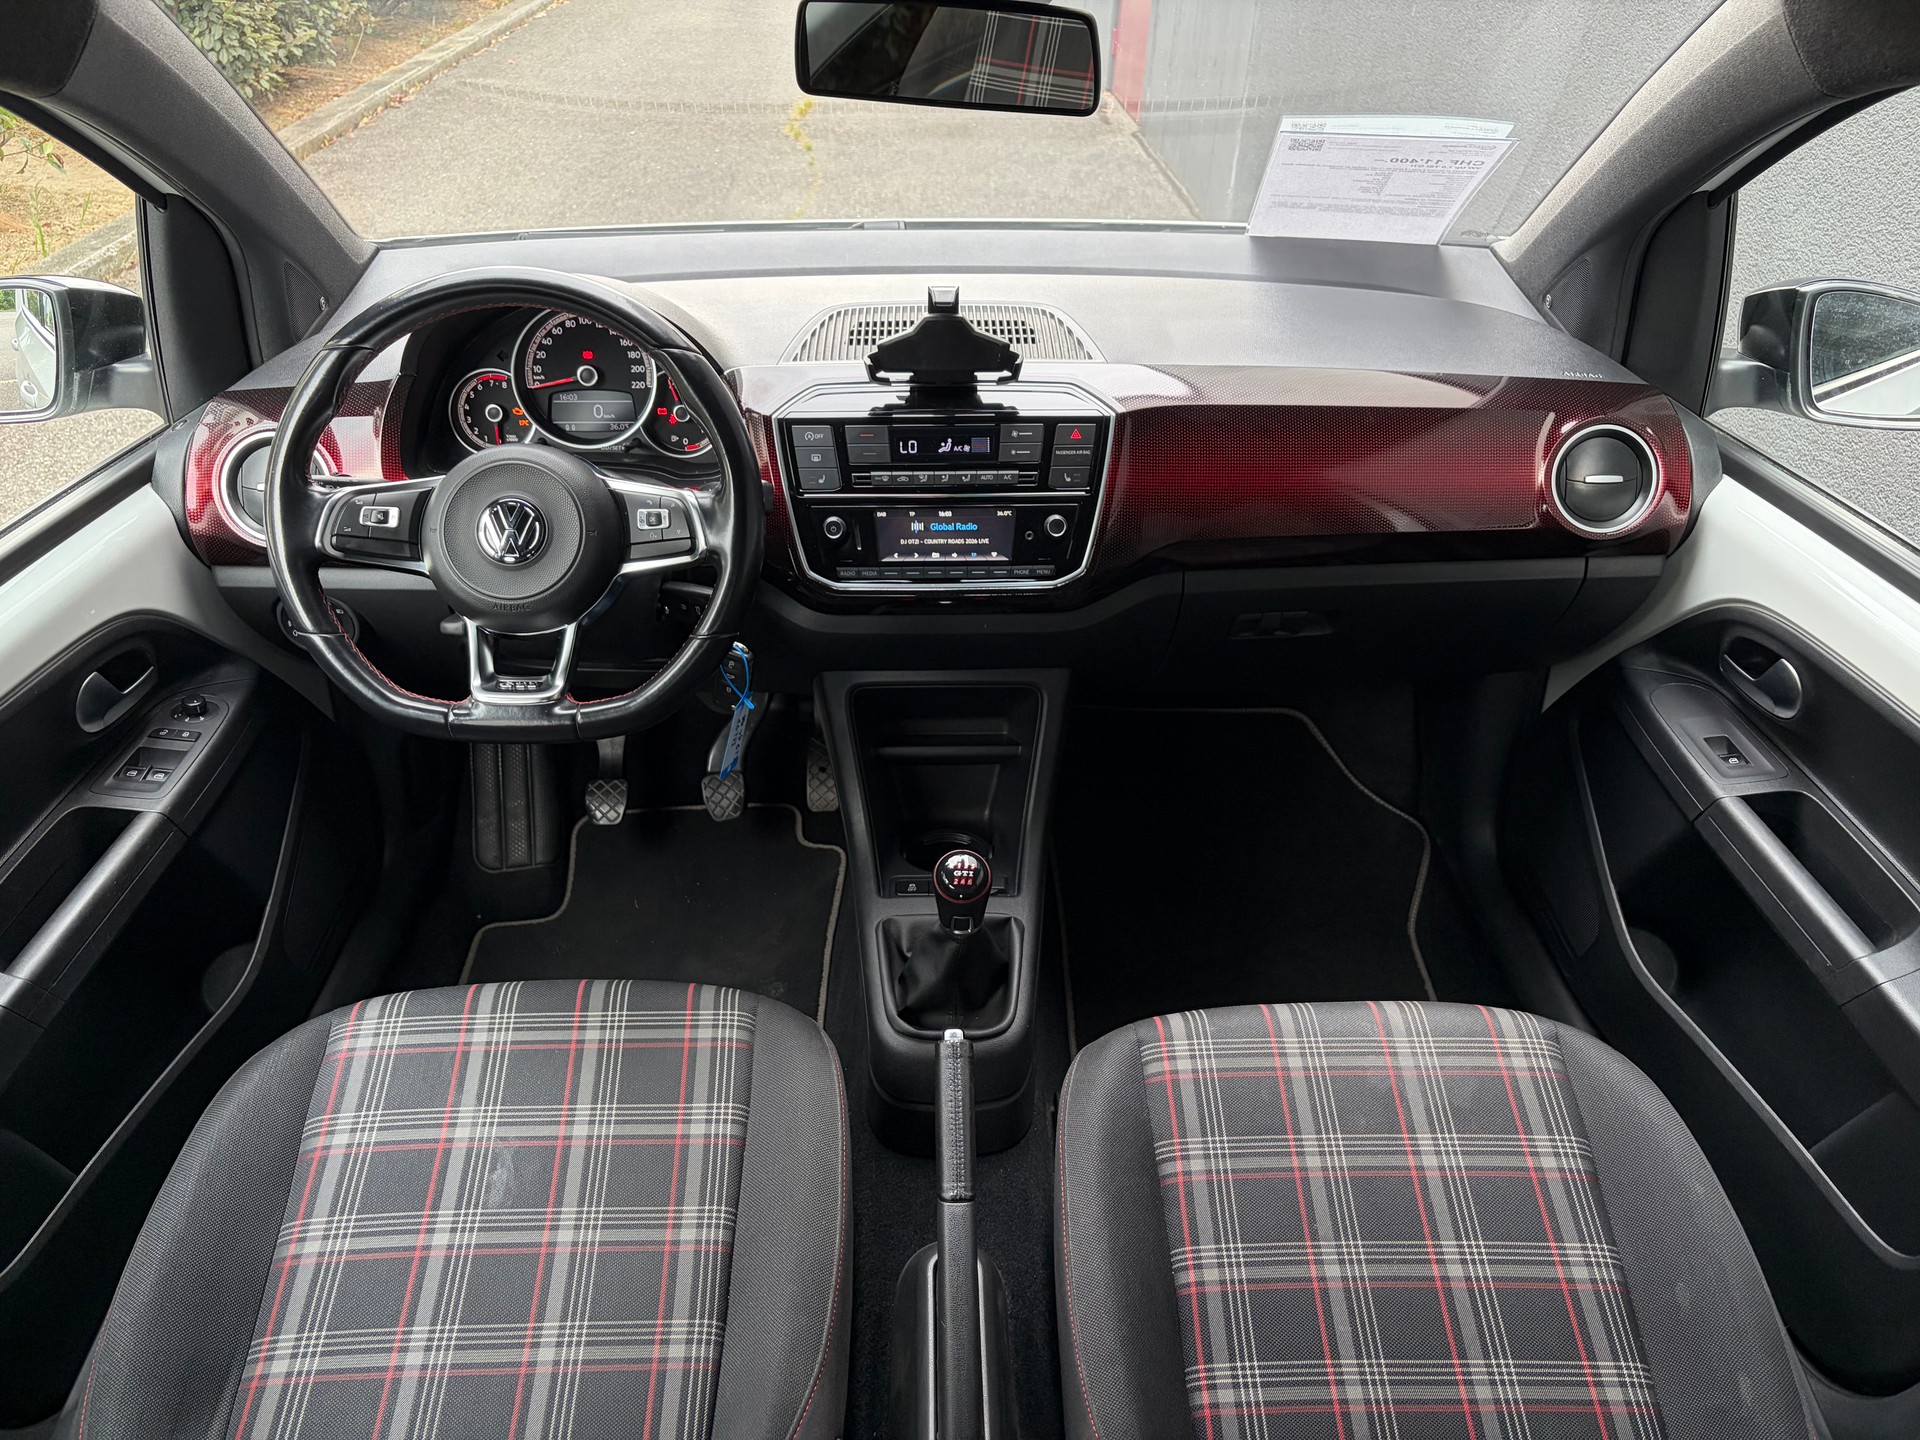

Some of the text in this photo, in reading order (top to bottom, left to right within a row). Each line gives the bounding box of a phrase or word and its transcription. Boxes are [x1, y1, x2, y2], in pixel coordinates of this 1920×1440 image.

[565, 320, 576, 328] 80
[551, 327, 563, 335] 60
[536, 351, 546, 359] 20
[627, 351, 641, 359] 180
[533, 365, 542, 373] 10
[630, 365, 645, 373] 200
[501, 381, 508, 389] 8
[631, 381, 646, 389] 220
[593, 404, 603, 418] 0
[473, 427, 479, 435] 2
[477, 497, 547, 564] VW
[930, 522, 978, 531] Global Radio
